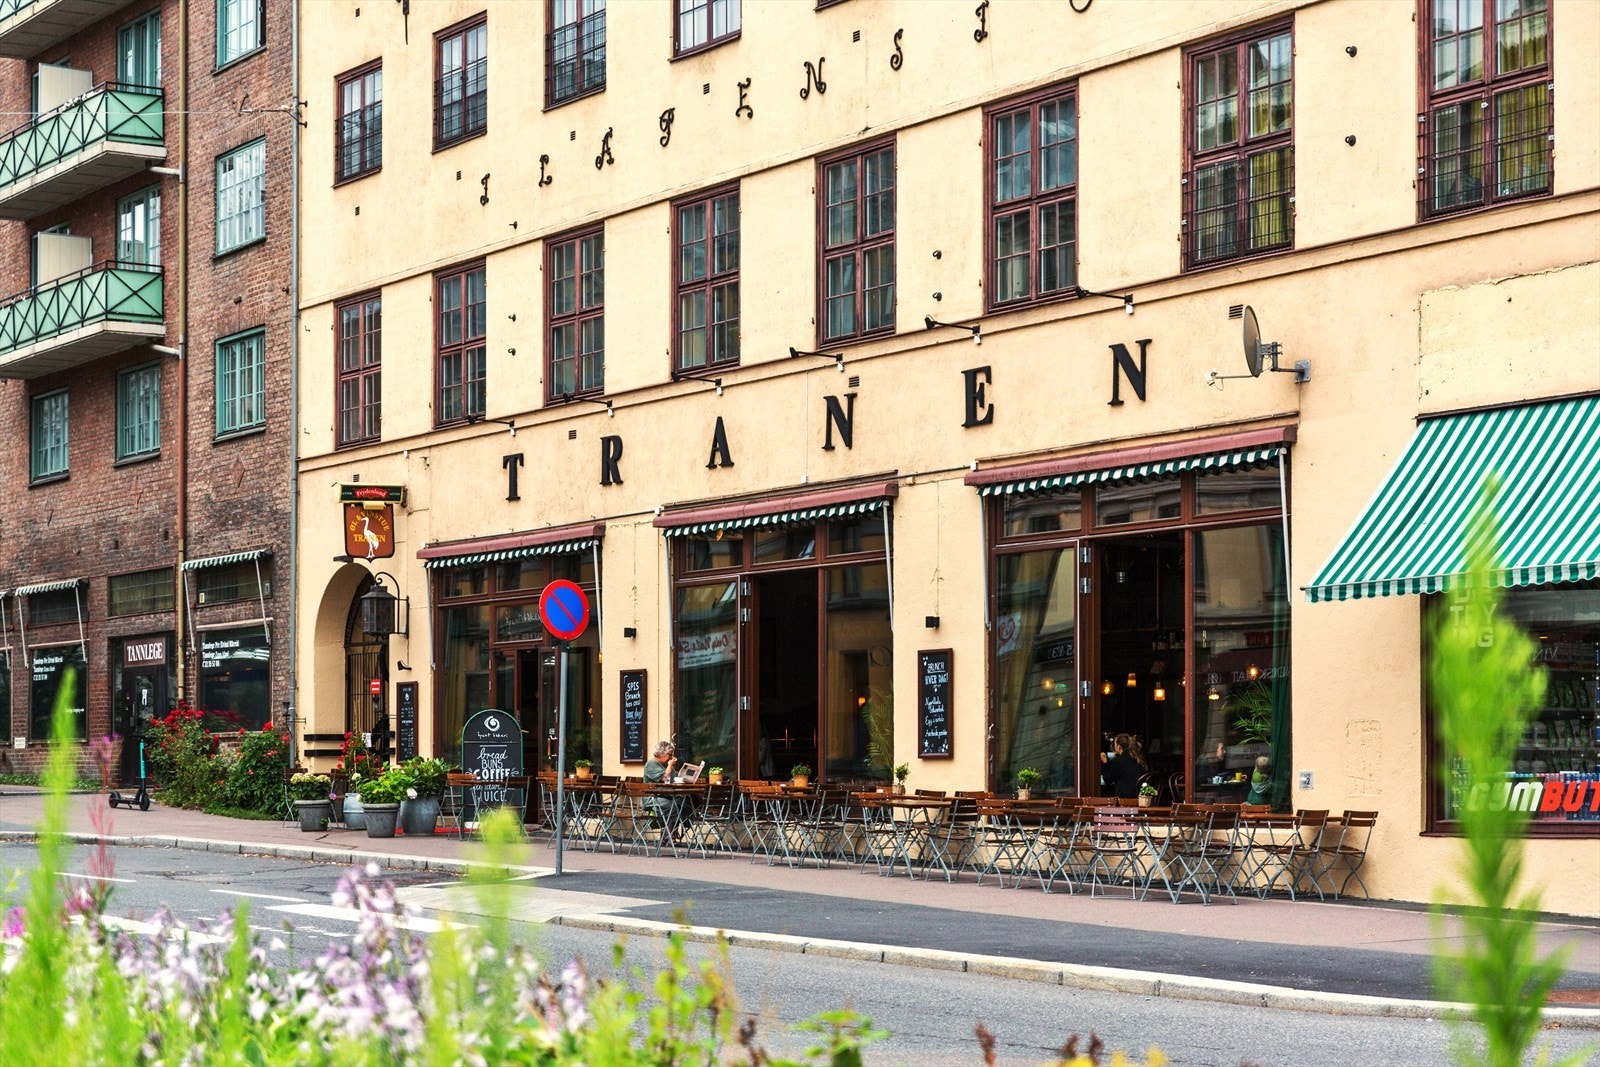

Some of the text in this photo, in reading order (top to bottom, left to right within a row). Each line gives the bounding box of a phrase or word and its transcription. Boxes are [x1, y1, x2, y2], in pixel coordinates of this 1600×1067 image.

[502, 339, 1152, 501] TRANEN
[127, 643, 163, 662] TANNLEGE
[627, 681, 640, 692] SPIS
[477, 747, 508, 760] bread
[481, 759, 503, 769] BUNS
